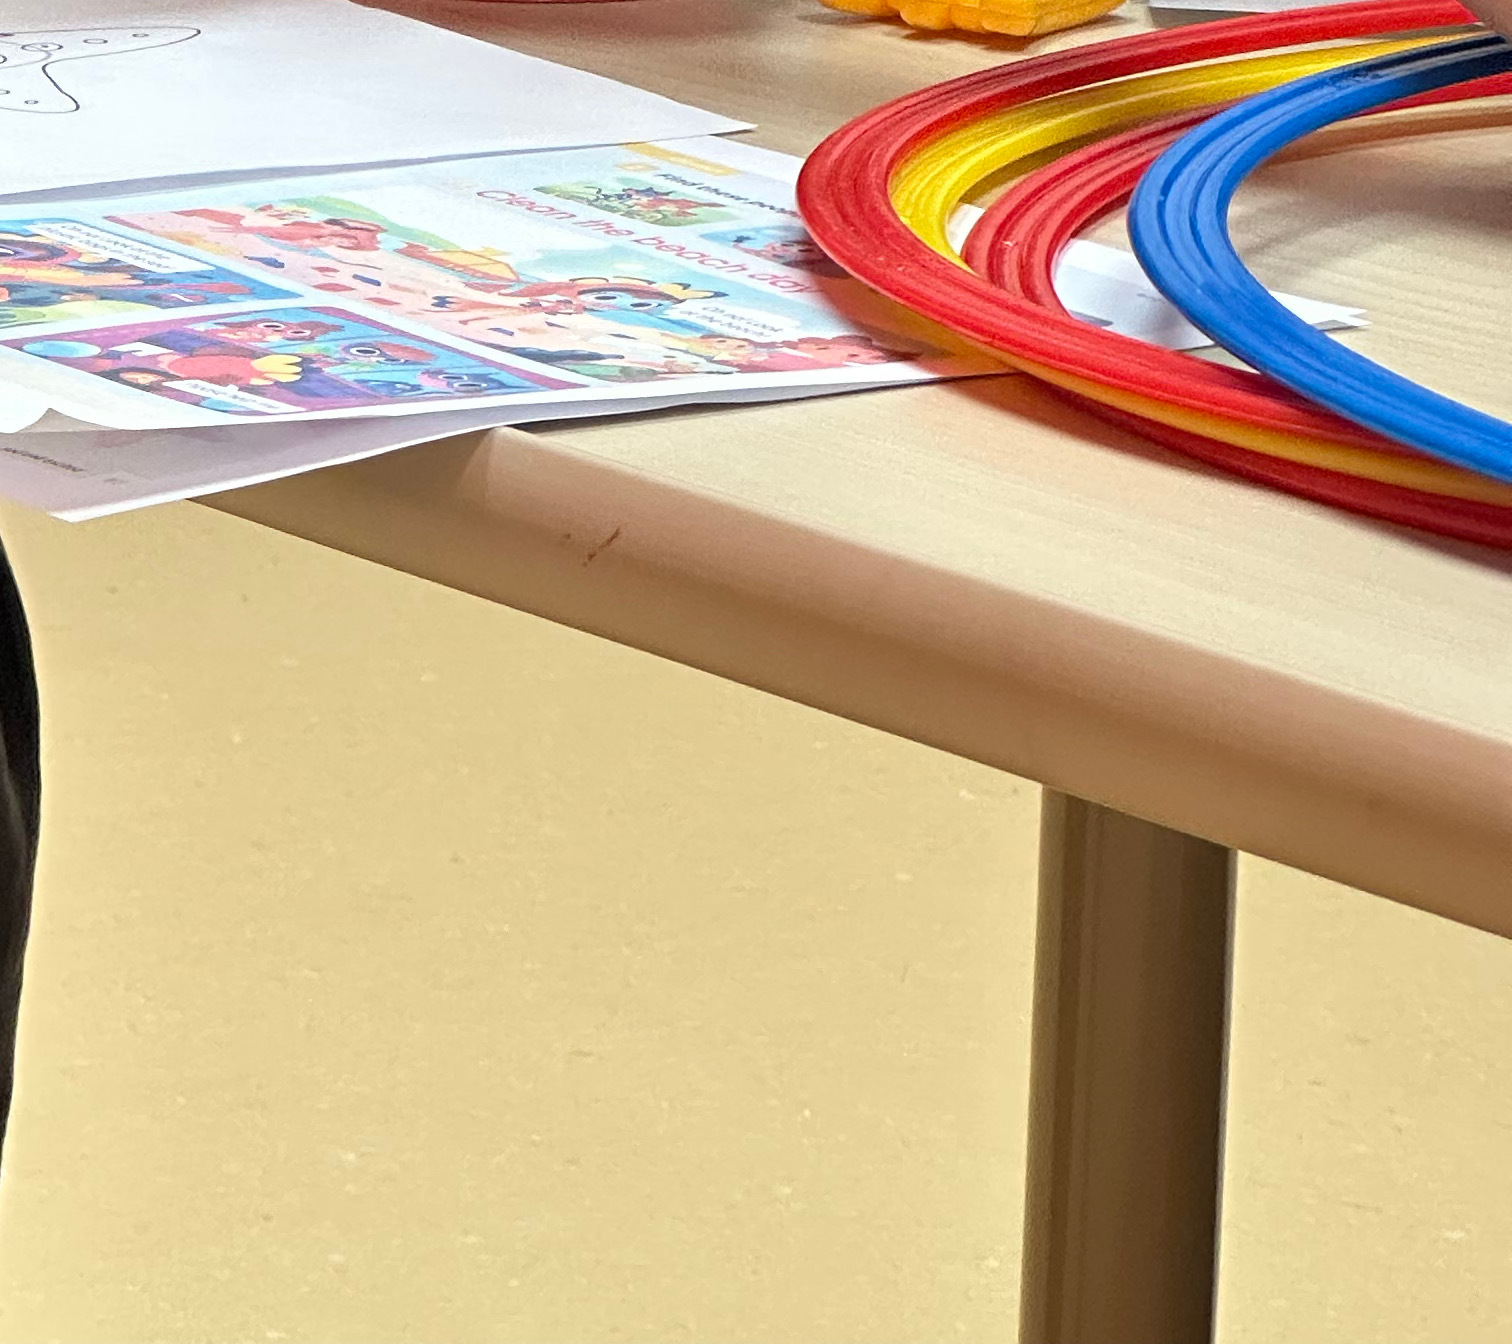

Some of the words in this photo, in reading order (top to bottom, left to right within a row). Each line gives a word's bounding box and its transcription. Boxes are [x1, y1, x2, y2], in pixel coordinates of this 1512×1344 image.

[476, 189, 577, 220] Clean
[572, 219, 635, 237] the
[631, 235, 750, 273] beach
[748, 272, 824, 294] day
